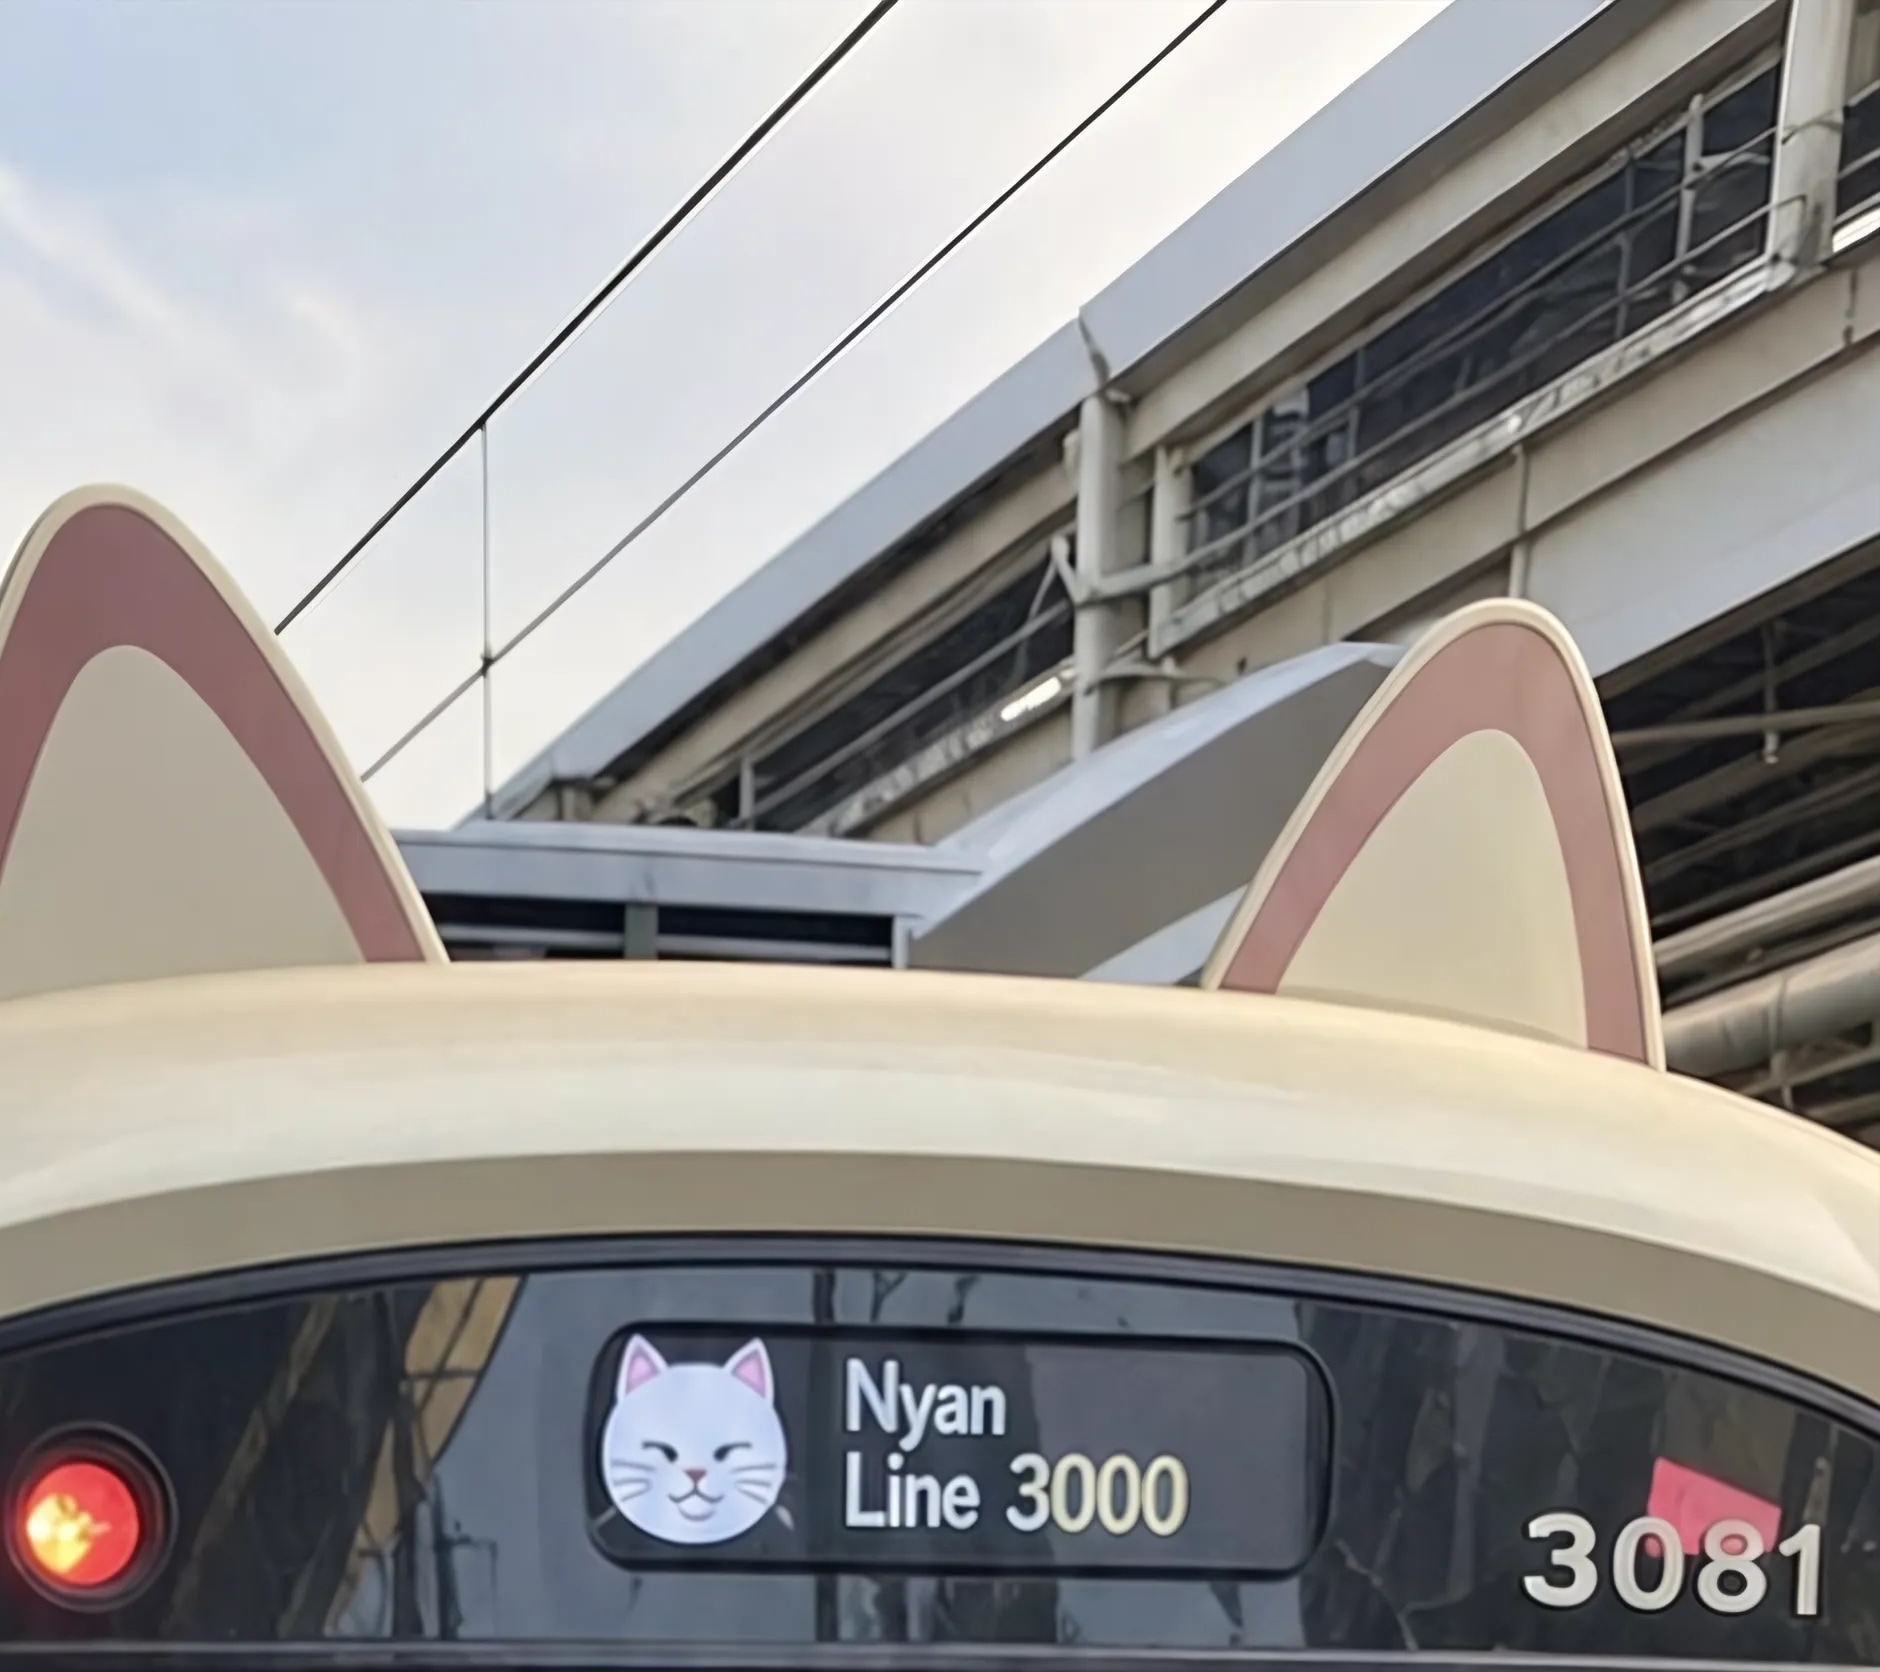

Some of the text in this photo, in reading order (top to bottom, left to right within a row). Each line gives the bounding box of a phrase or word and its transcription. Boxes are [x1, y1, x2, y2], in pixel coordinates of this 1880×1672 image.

[844, 1357, 1007, 1452] Nyan
[844, 1450, 1188, 1537] Line 3000
[1521, 1510, 1822, 1618] 3081
